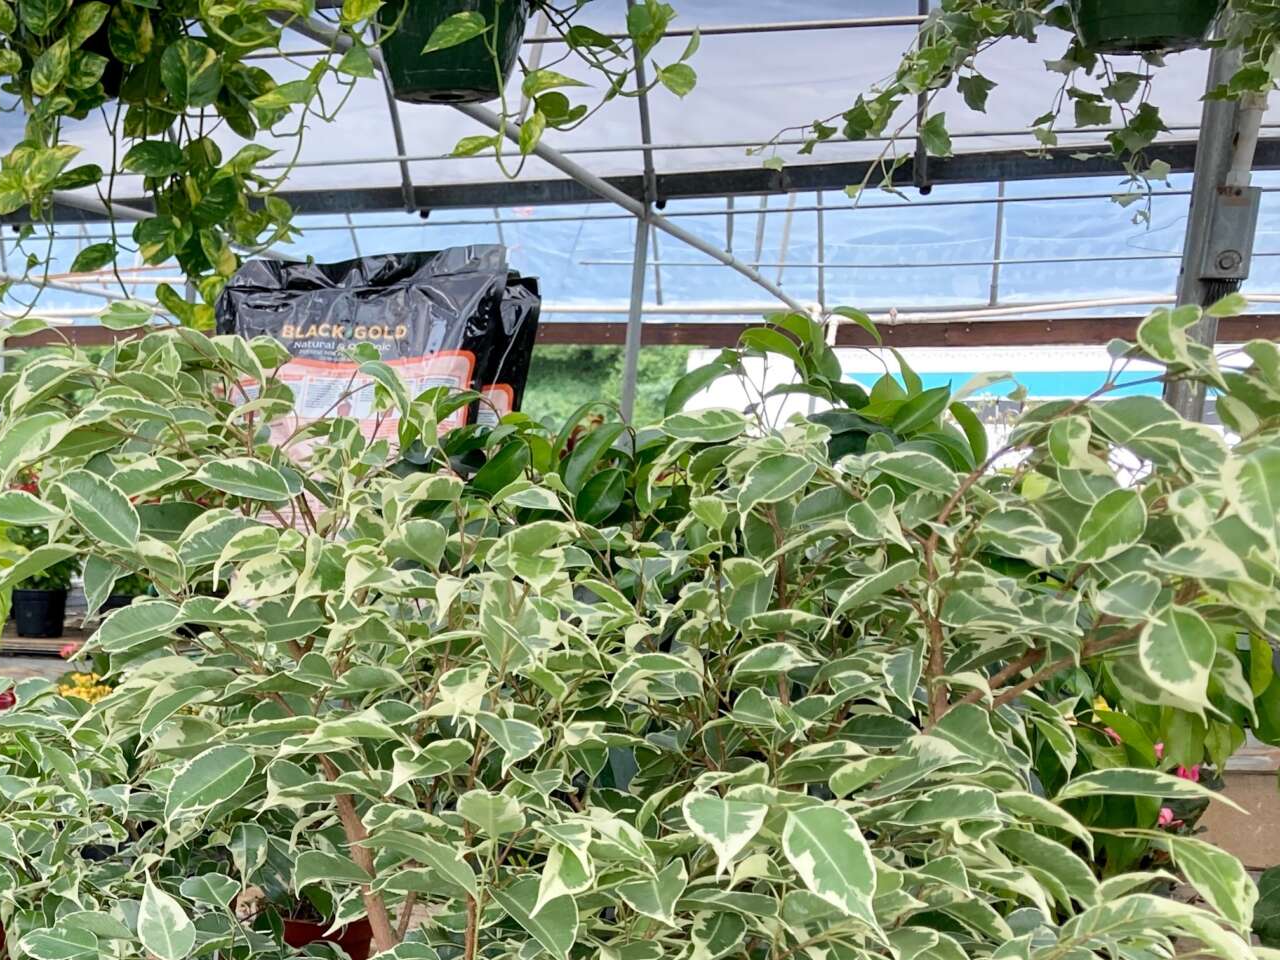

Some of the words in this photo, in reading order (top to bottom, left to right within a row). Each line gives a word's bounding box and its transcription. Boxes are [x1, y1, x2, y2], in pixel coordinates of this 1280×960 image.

[281, 323, 345, 338] BLACK
[354, 325, 408, 339] GOLD
[293, 340, 335, 350] Natural
